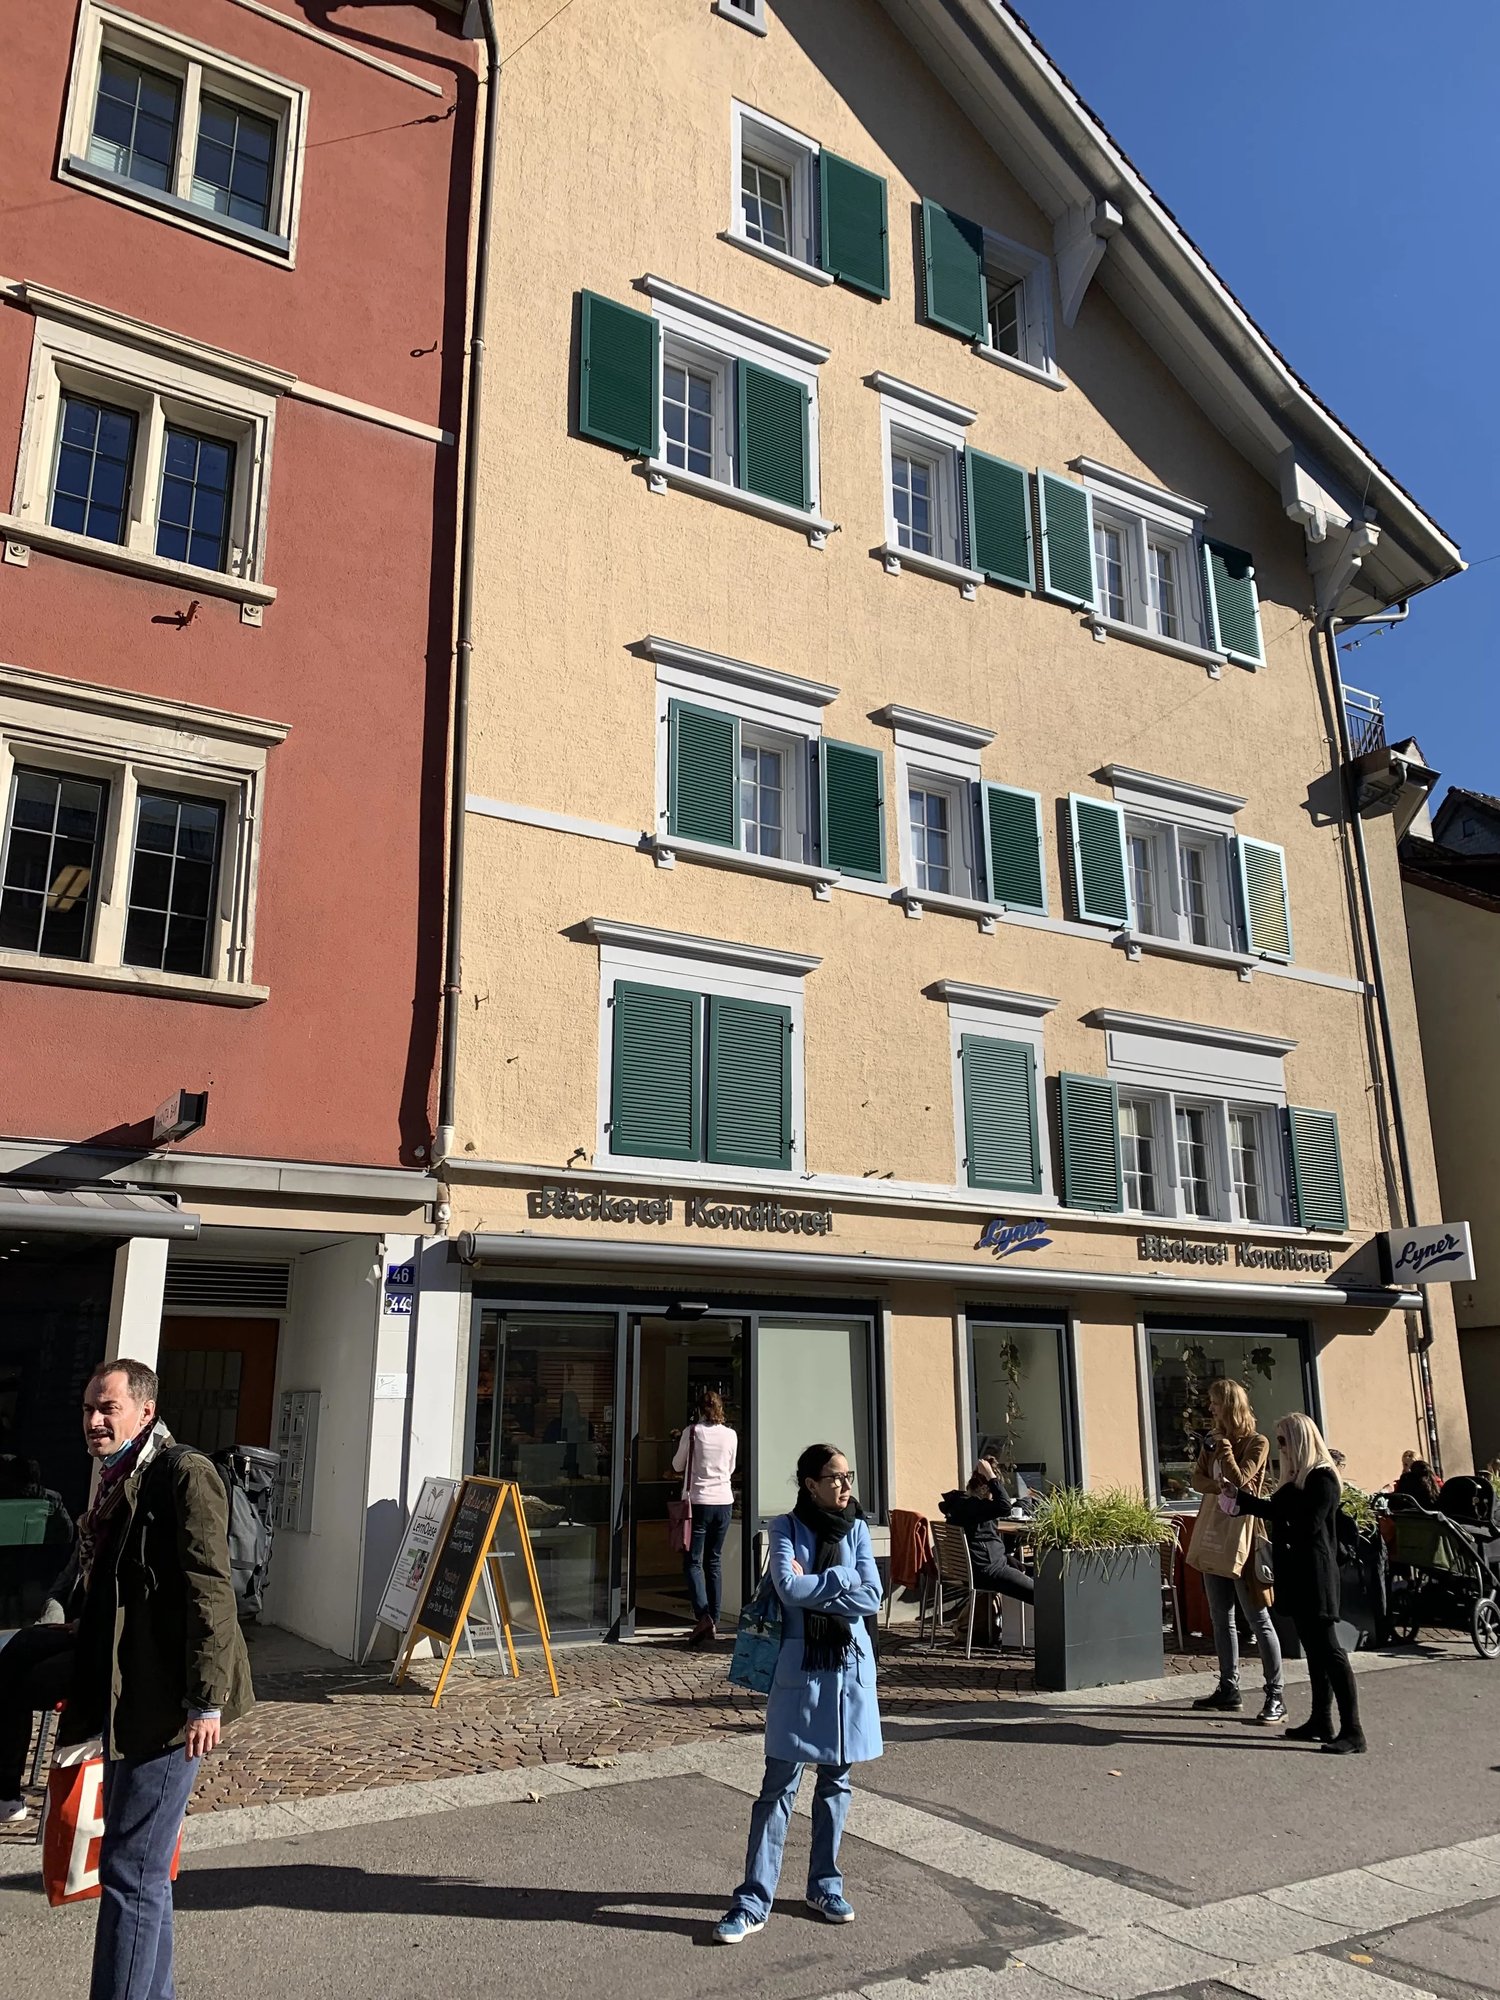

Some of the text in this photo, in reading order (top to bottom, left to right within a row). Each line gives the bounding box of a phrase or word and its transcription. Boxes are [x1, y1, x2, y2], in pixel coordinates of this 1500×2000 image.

[540, 1185, 833, 1233] Bäckerei Konditorei
[979, 1217, 1051, 1253] Lyner
[1143, 1233, 1333, 1271] Bäckerei Konditorei
[1395, 1233, 1461, 1270] Lyner
[392, 1267, 410, 1283] 46
[390, 1296, 408, 1312] 44
